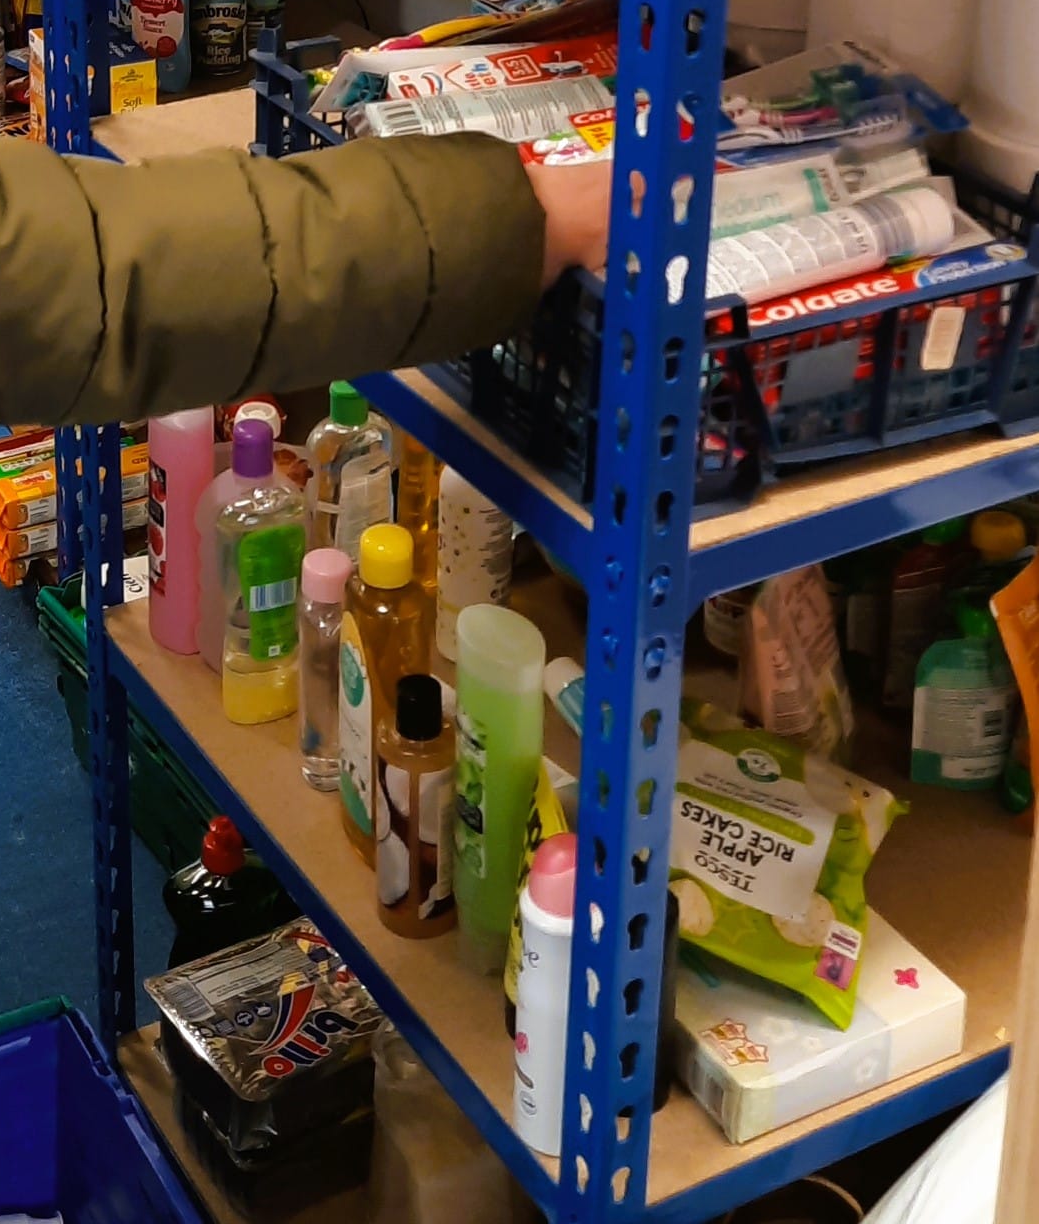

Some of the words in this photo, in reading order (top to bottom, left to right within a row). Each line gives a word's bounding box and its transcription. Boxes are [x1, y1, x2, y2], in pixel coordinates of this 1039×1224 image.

[573, 109, 613, 124] Col
[748, 276, 900, 326] Colgate
[681, 801, 744, 839] CAKES
[700, 830, 763, 866] APPLE
[748, 830, 795, 863] RICE
[694, 853, 755, 893] TESCO
[262, 1008, 360, 1079] brillo
